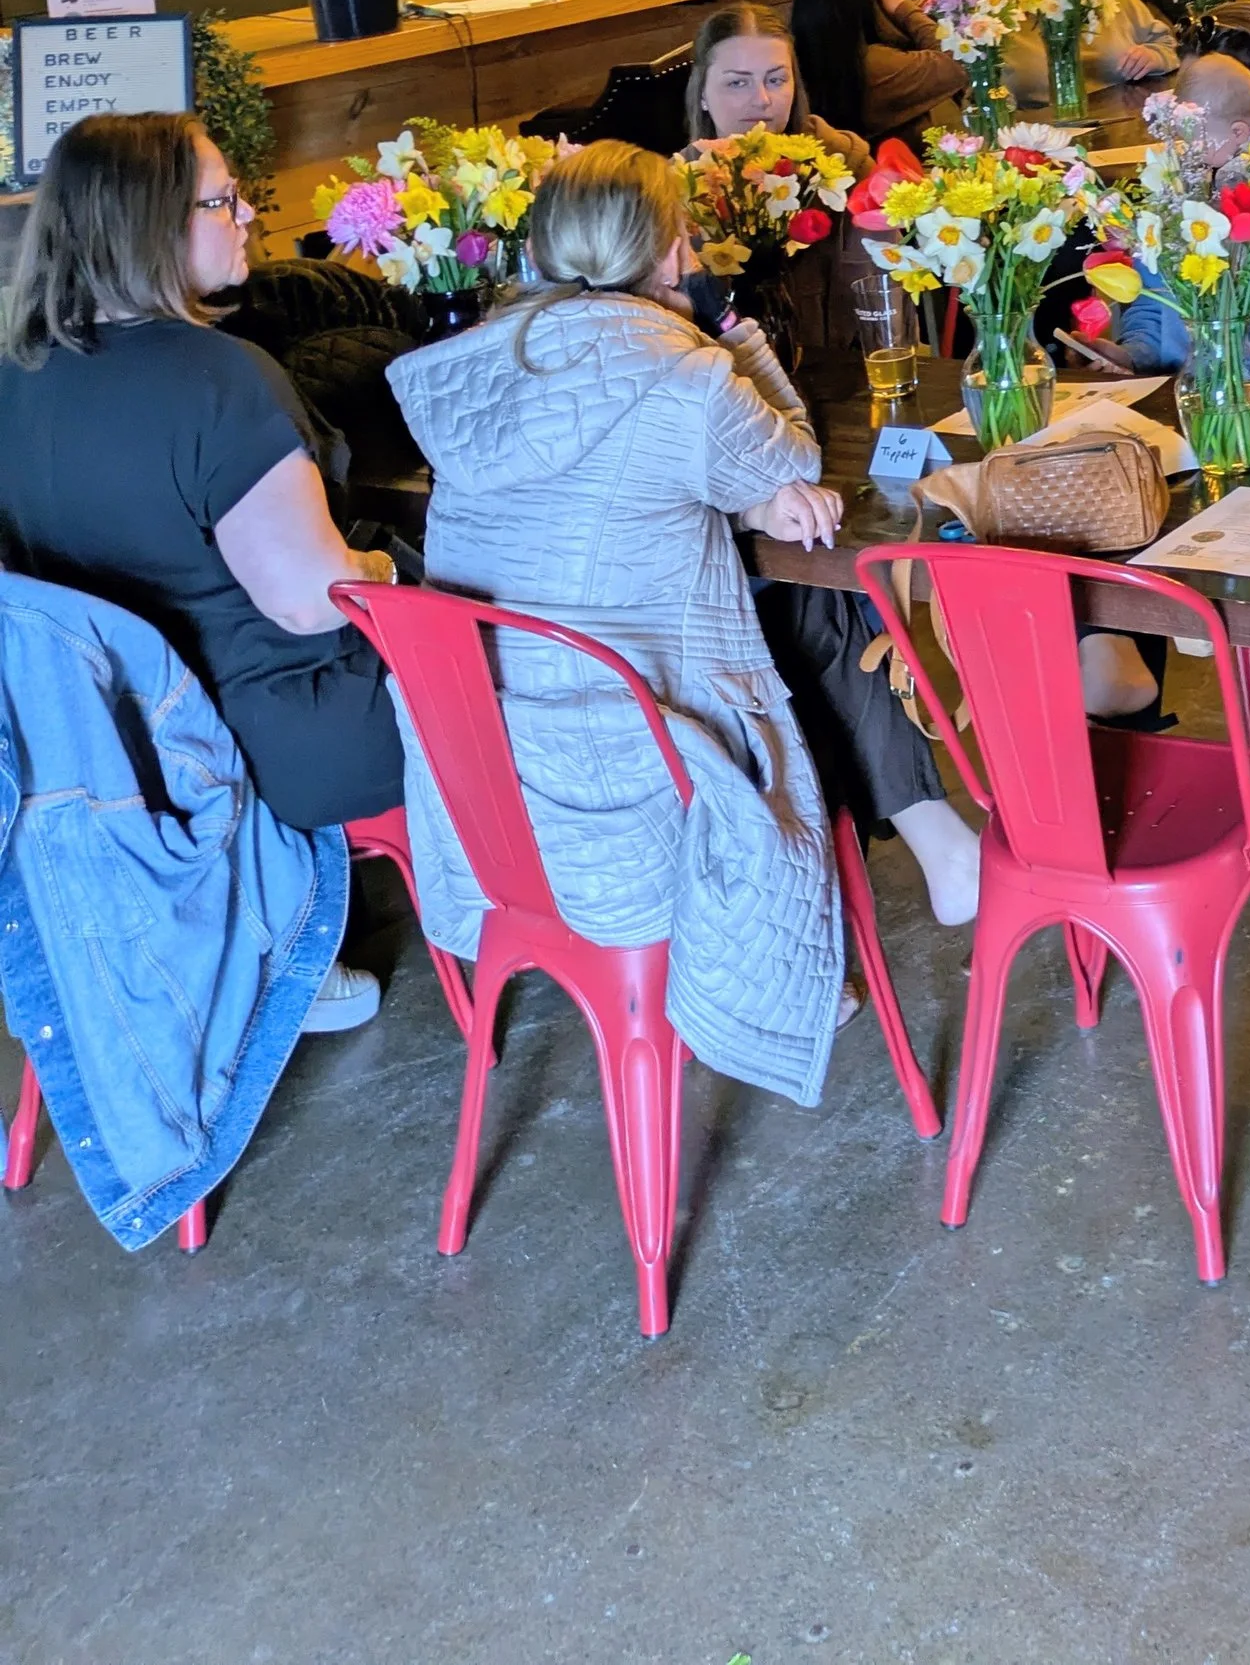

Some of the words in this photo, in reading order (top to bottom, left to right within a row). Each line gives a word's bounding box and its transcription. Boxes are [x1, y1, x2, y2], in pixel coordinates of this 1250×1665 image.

[65, 26, 142, 41] BEER
[44, 52, 102, 67] BREW
[45, 73, 112, 88] ENJOY
[45, 98, 117, 113] EMPTY
[898, 433, 908, 445] 6
